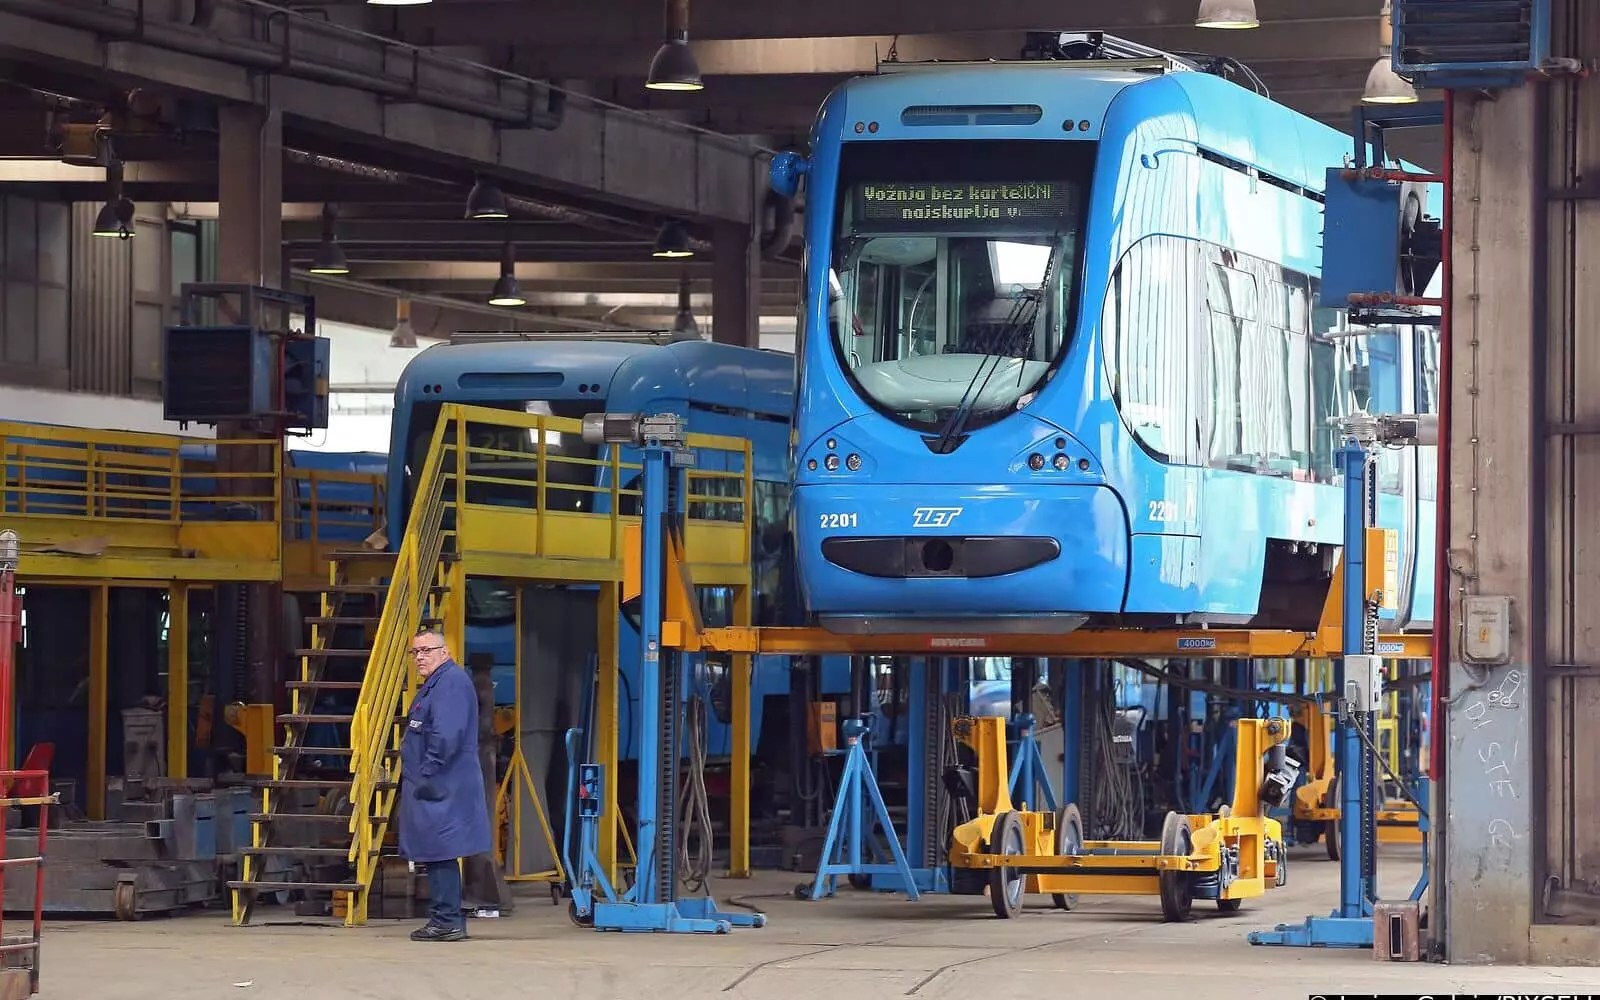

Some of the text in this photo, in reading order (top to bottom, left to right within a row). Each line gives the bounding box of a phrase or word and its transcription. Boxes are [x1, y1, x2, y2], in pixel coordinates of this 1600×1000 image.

[864, 184, 925, 201] Vožnja
[931, 185, 963, 200] bez
[902, 204, 1000, 219] najskuplja
[820, 512, 858, 529] 2201
[912, 507, 964, 528] ZET
